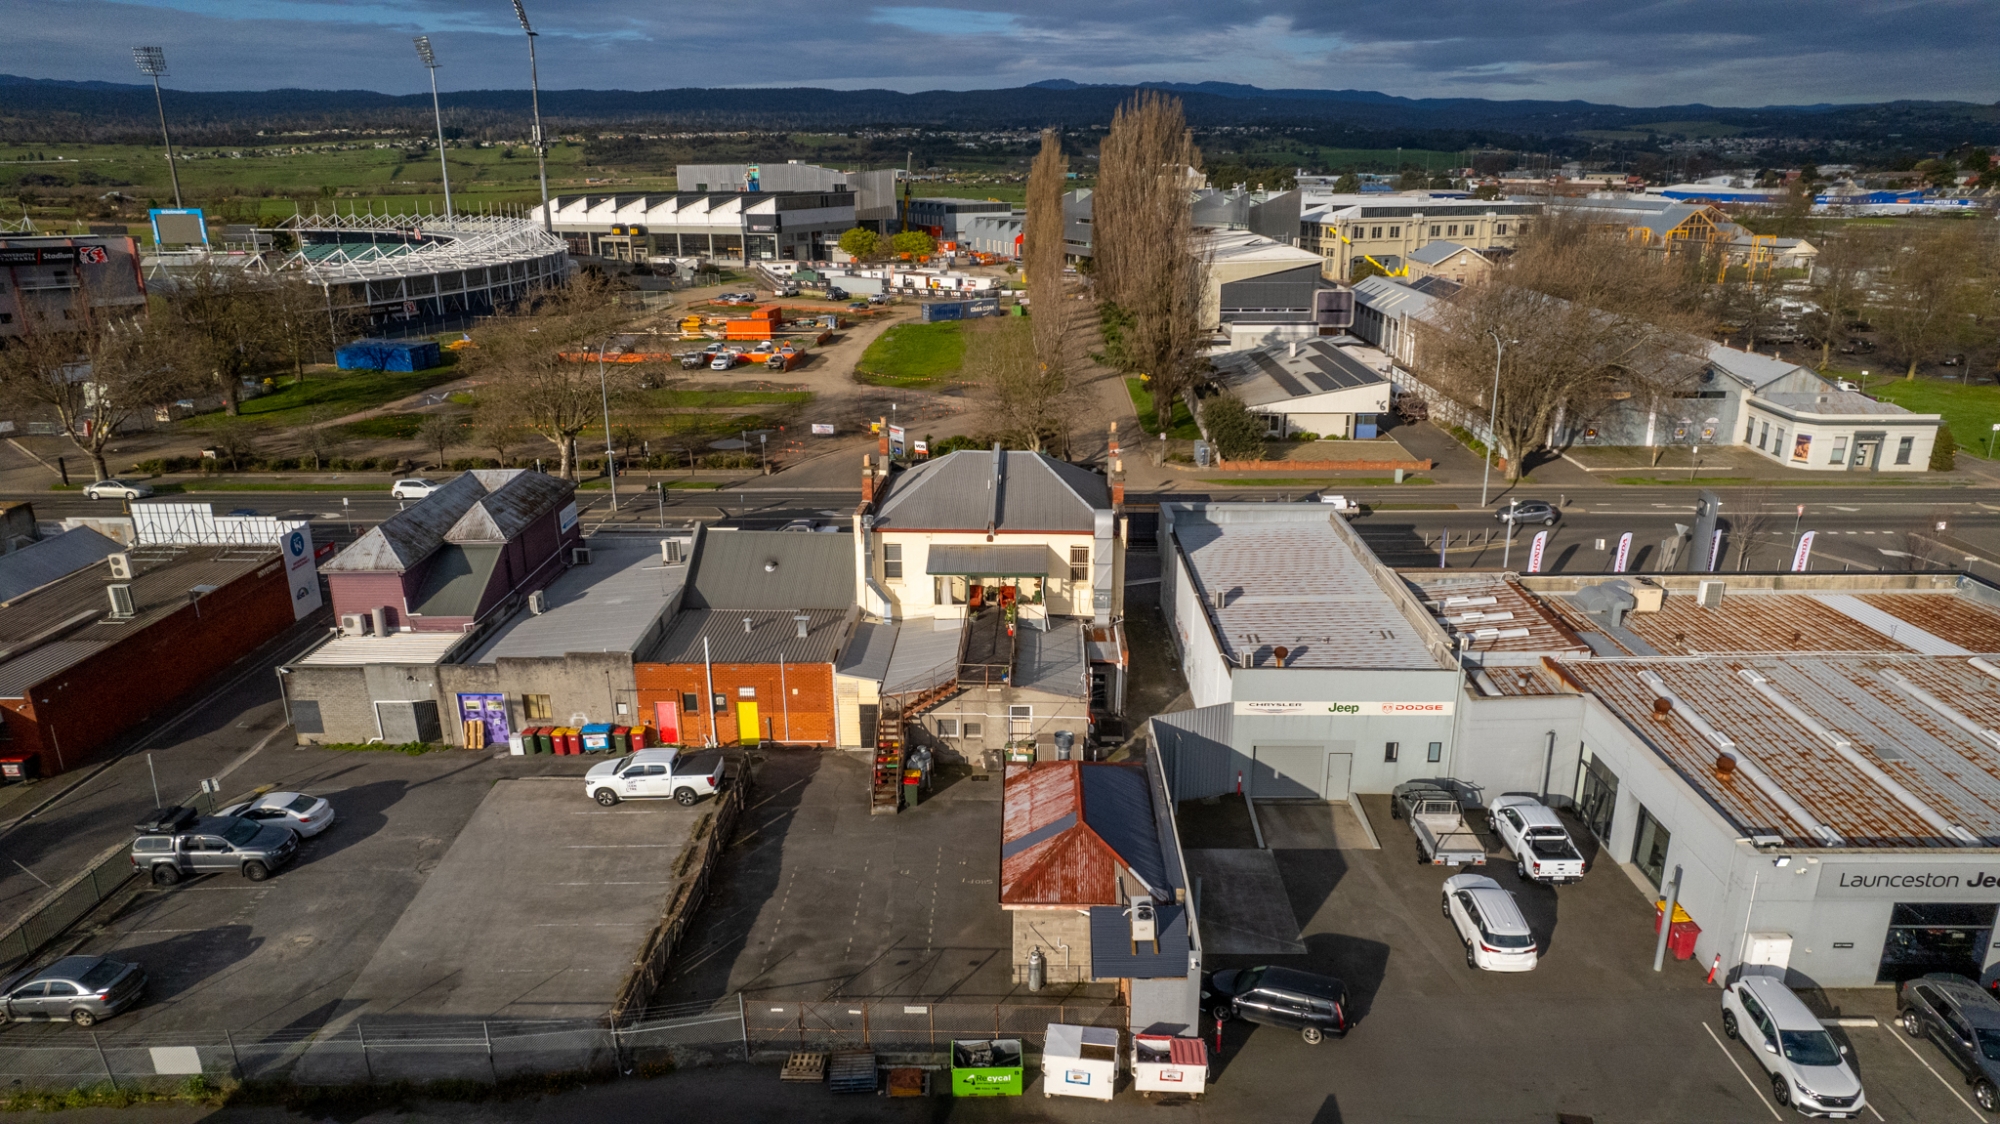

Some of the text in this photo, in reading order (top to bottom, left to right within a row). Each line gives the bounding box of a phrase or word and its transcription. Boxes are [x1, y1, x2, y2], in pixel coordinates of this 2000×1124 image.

[42, 252, 74, 260] Stadium
[1531, 537, 1542, 573] HONDA
[1617, 538, 1628, 573] HONDA
[1797, 537, 1810, 572] HONDA
[1328, 702, 1360, 714] Jeep
[1839, 871, 2000, 888] Launceston Je
[976, 1074, 1011, 1083] Recycal
